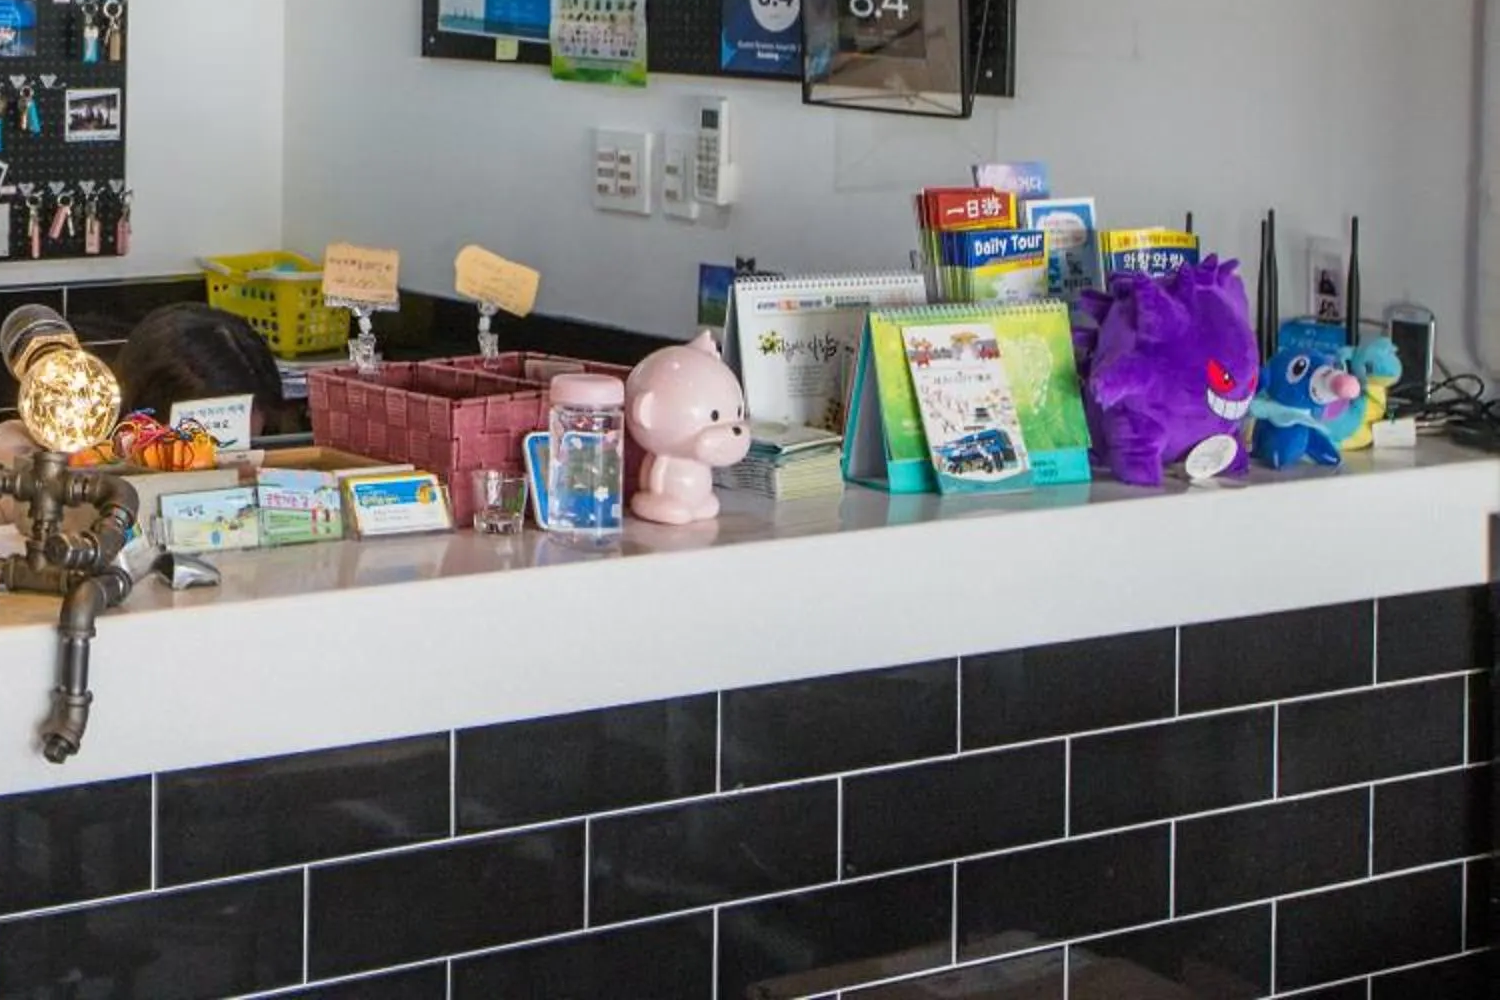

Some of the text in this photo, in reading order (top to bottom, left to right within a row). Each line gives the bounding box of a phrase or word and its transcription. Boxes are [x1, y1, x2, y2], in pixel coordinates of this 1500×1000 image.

[945, 193, 1002, 218] 一日游
[974, 233, 1043, 257] Daily Tour
